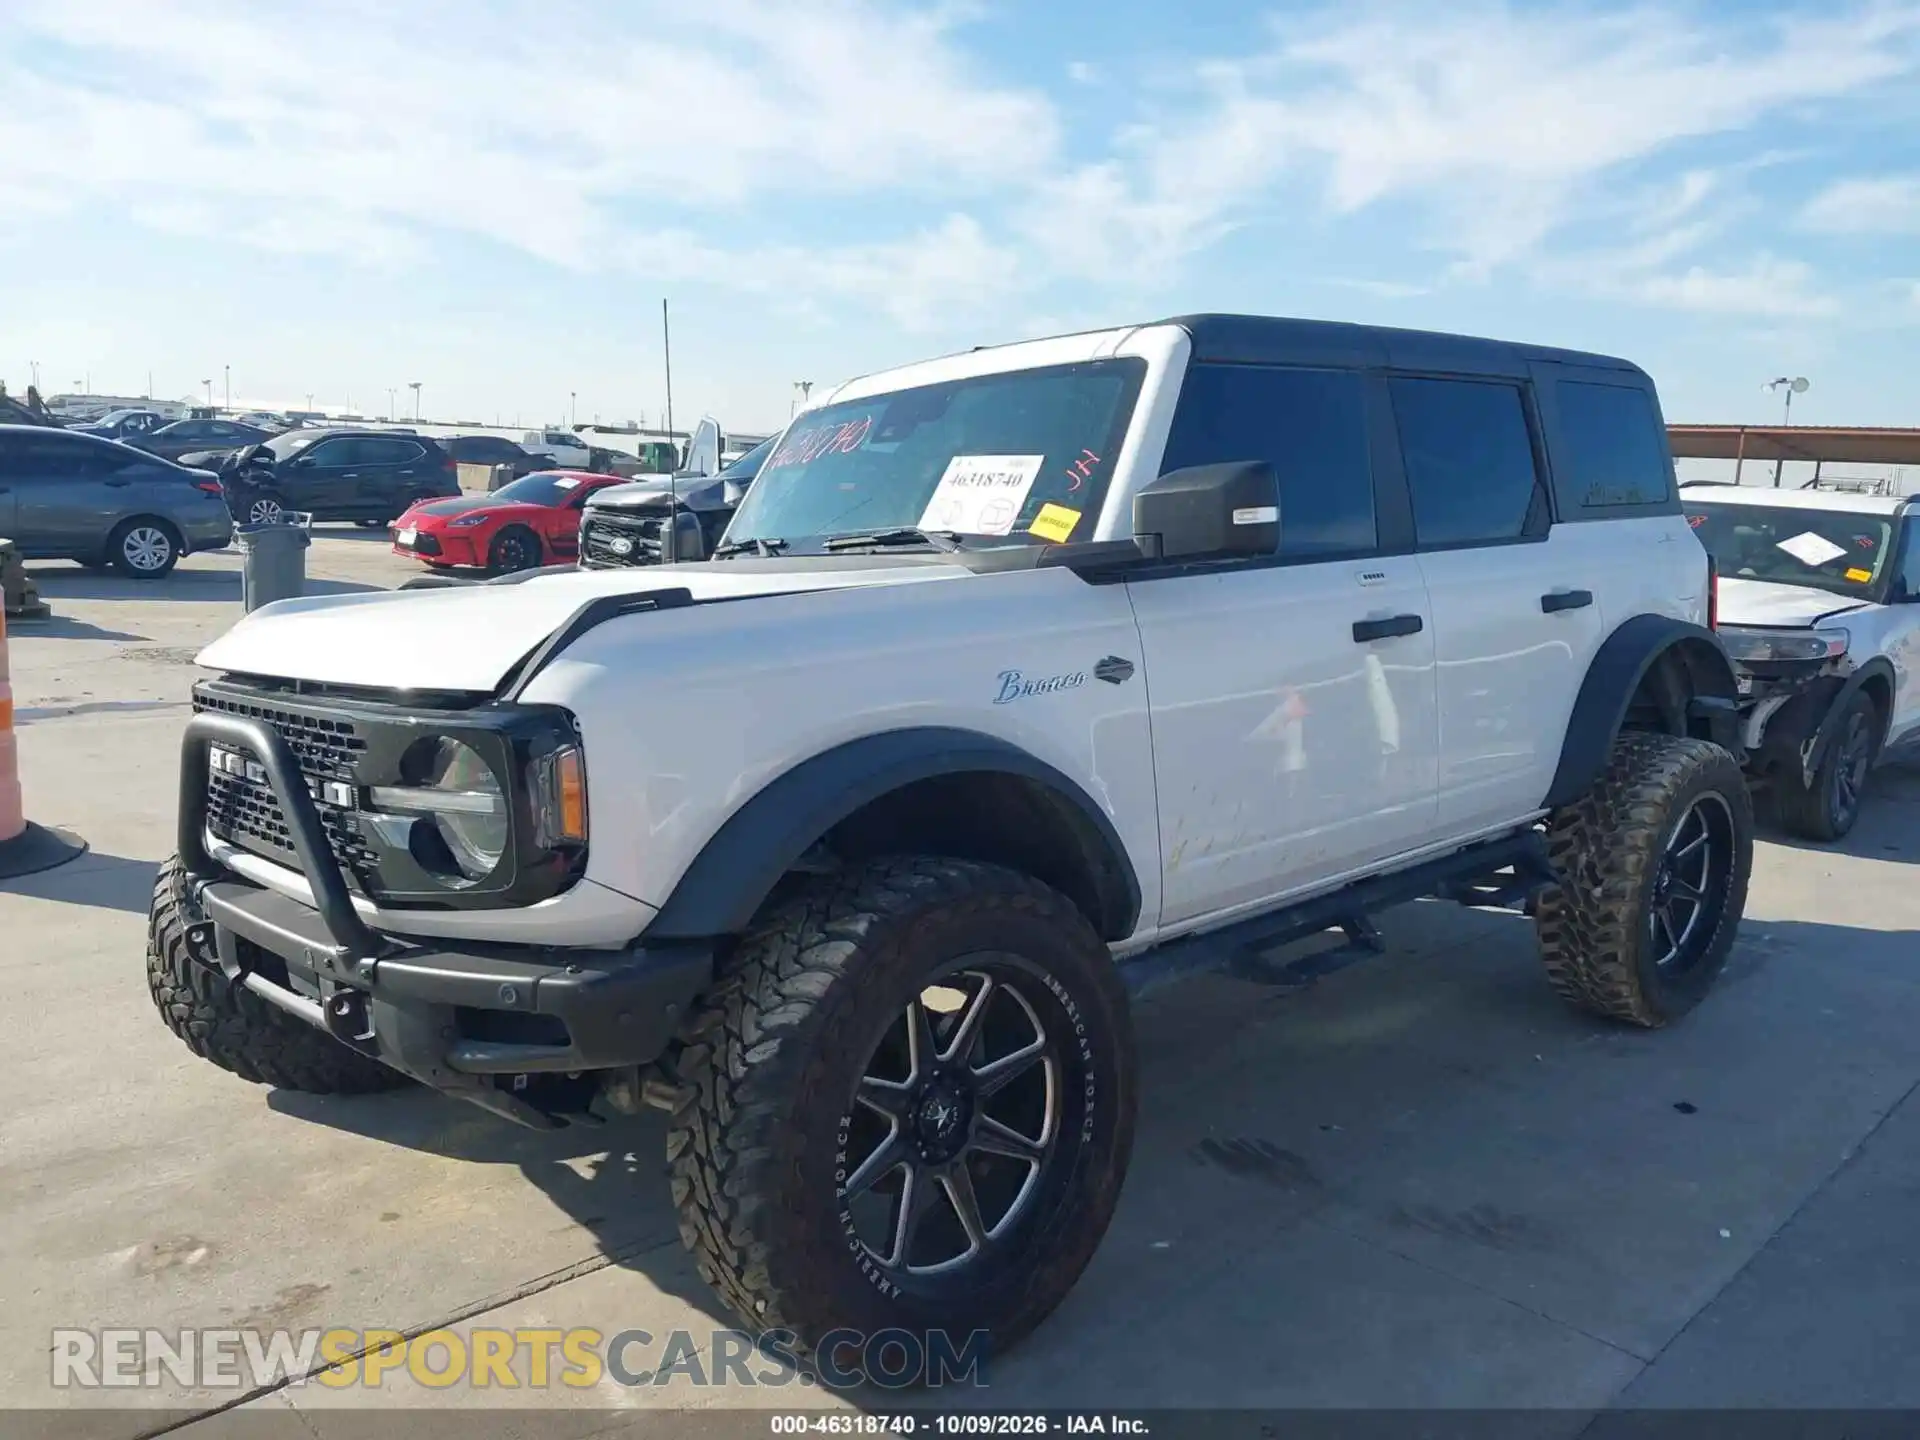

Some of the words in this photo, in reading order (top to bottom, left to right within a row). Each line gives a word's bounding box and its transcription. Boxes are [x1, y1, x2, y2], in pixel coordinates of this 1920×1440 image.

[947, 471, 1025, 489] 46318740
[992, 669, 1088, 705] Bronco
[1043, 974, 1092, 1061] AMERICAN
[1081, 1069, 1095, 1144] FORCE
[839, 1209, 902, 1300] AMERICAN
